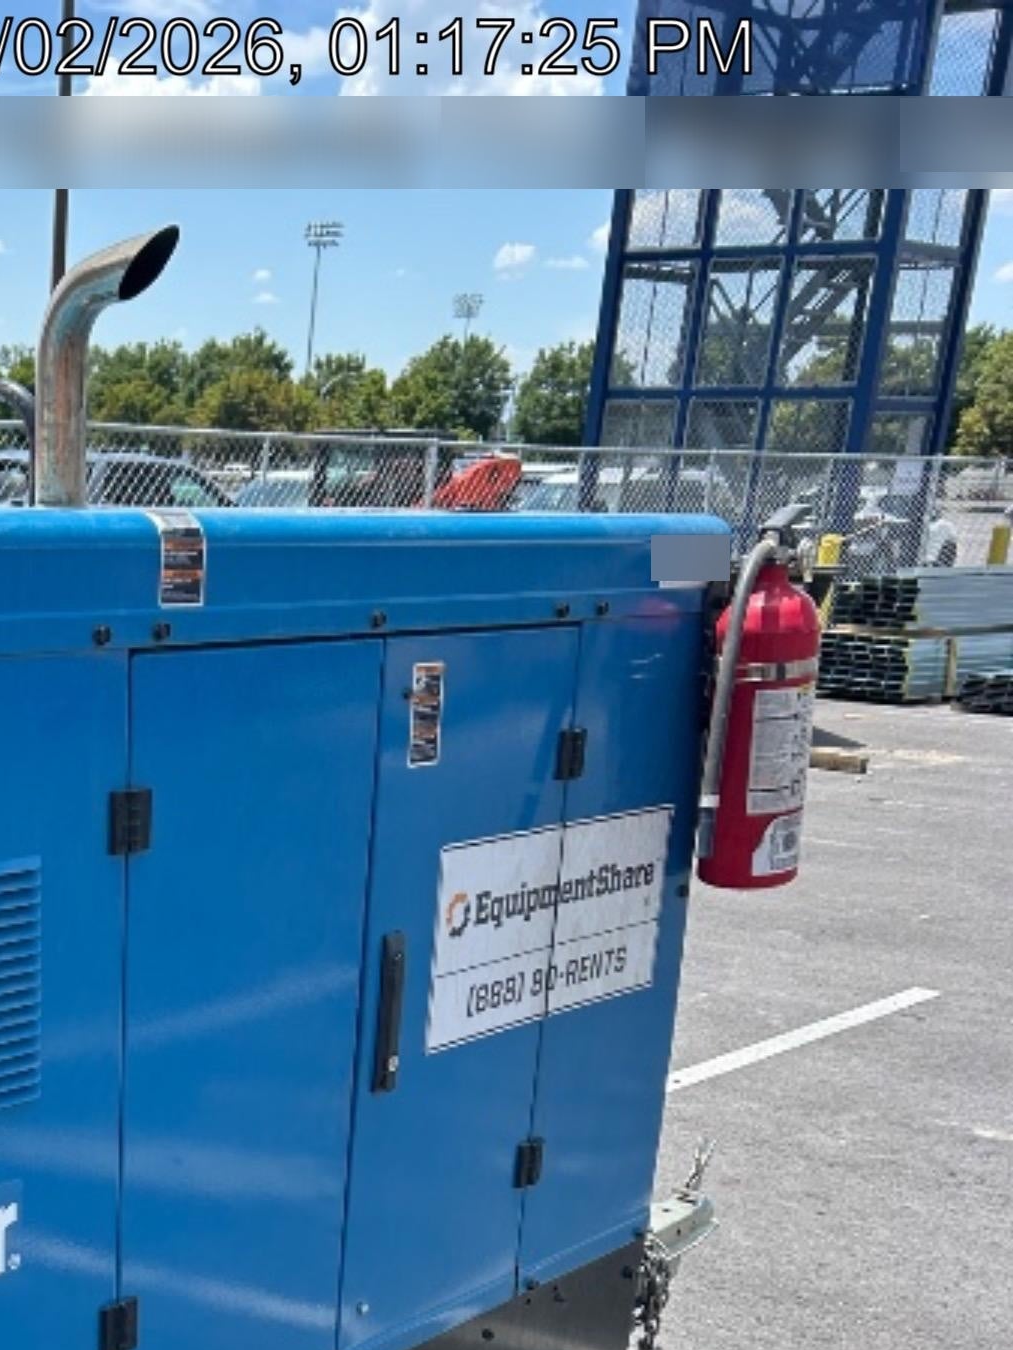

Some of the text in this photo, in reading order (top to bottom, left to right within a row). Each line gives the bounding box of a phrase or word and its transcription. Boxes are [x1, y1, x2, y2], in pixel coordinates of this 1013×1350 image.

[473, 861, 655, 931] EquipmentShare
[466, 946, 629, 1019] (888) 80-RENTS
